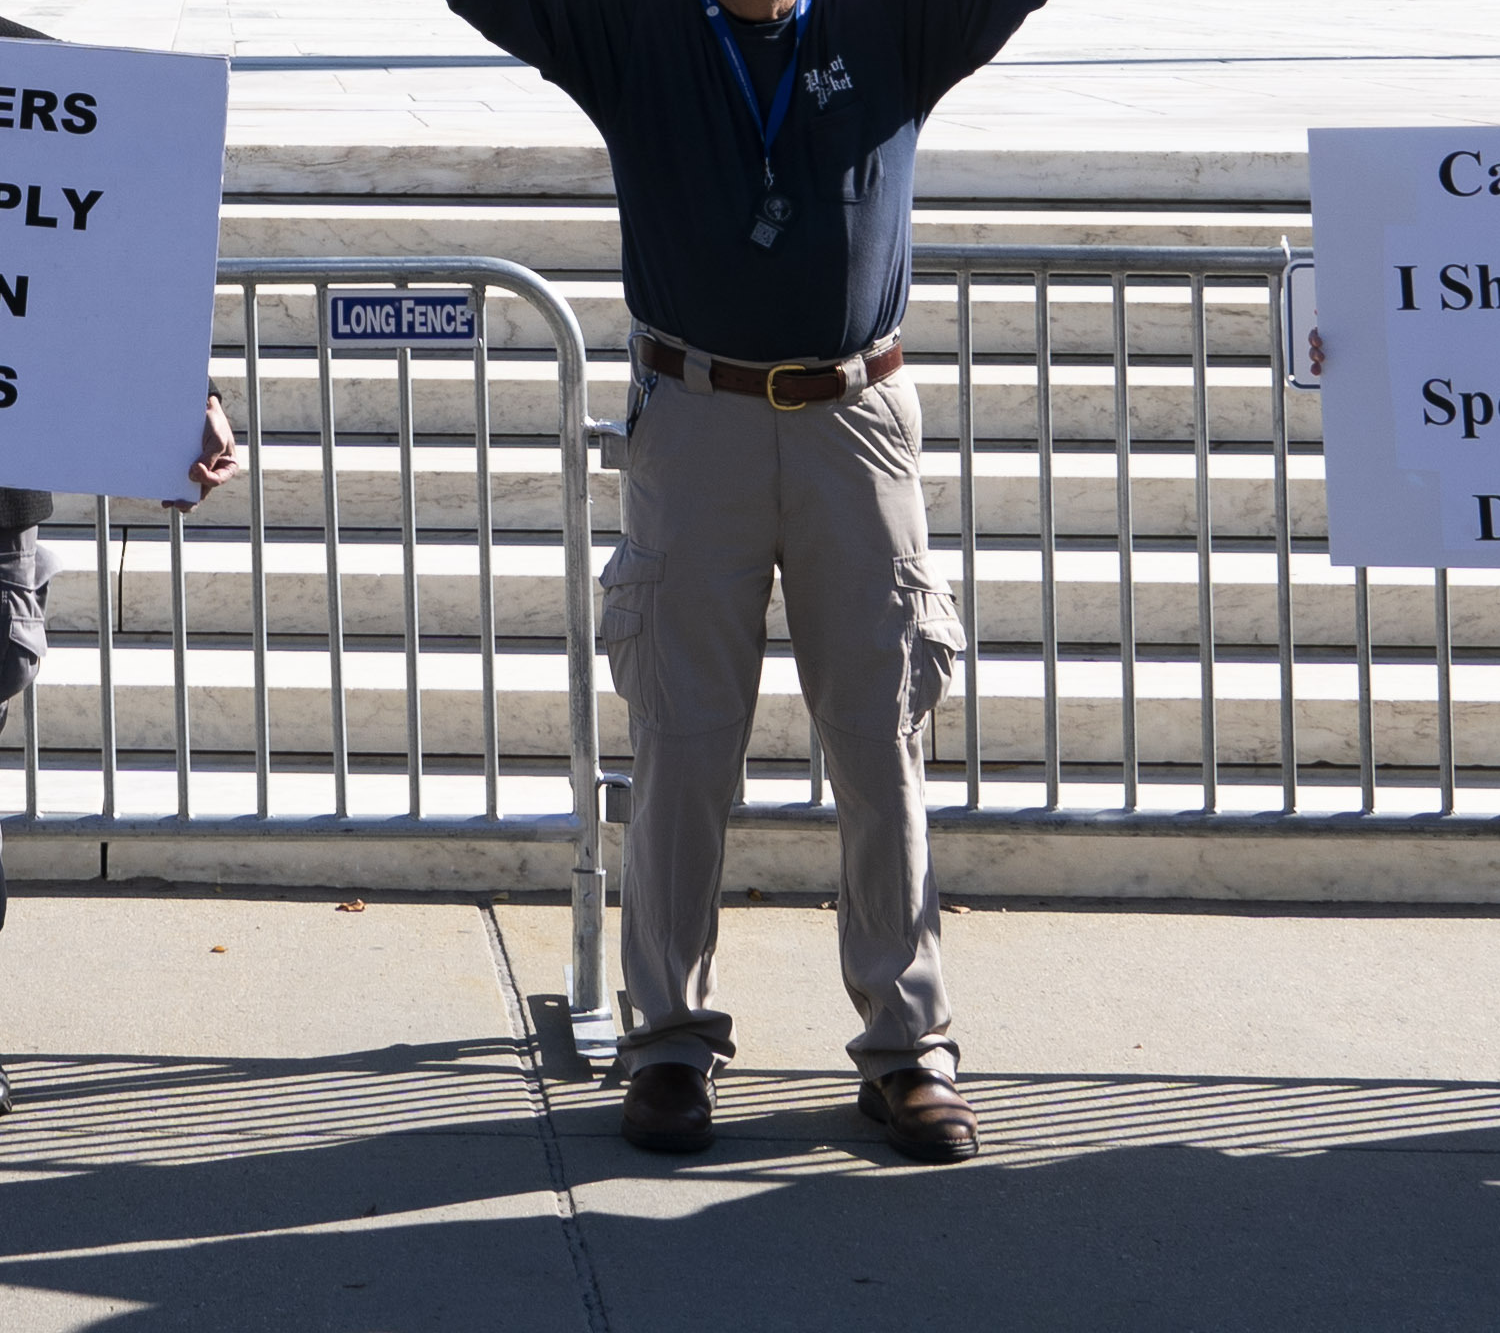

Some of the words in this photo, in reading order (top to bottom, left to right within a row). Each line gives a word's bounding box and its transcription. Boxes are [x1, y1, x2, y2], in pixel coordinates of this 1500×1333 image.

[1393, 264, 1421, 312] I
[337, 299, 396, 334] LONG
[401, 299, 469, 333] FENCE
